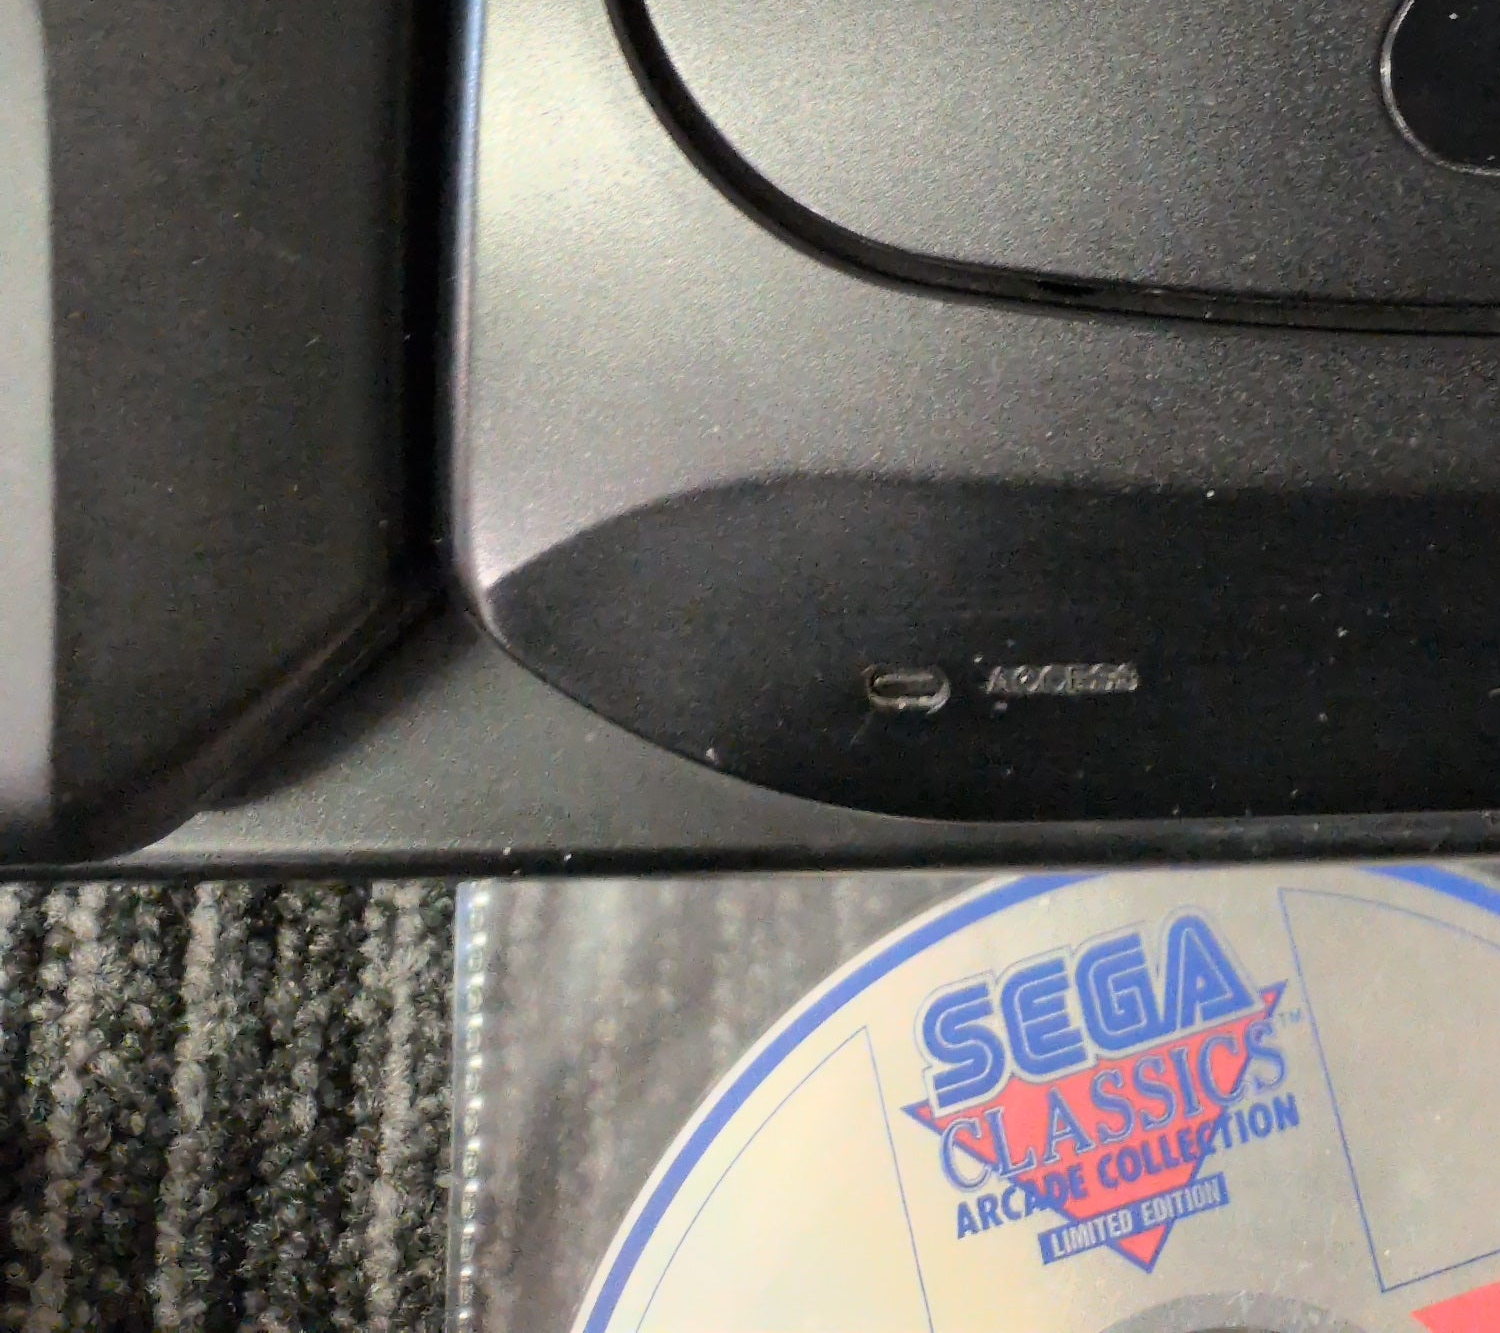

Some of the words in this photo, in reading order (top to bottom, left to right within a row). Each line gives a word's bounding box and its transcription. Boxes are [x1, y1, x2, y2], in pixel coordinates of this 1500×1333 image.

[920, 913, 1260, 1108] SEGA
[937, 1023, 1288, 1193] CLASSICS
[955, 1162, 1089, 1239] ARCADE
[1098, 1093, 1300, 1193] COLLECTION
[1050, 1211, 1134, 1261] LIMITED
[1142, 1181, 1221, 1227] EDITION
